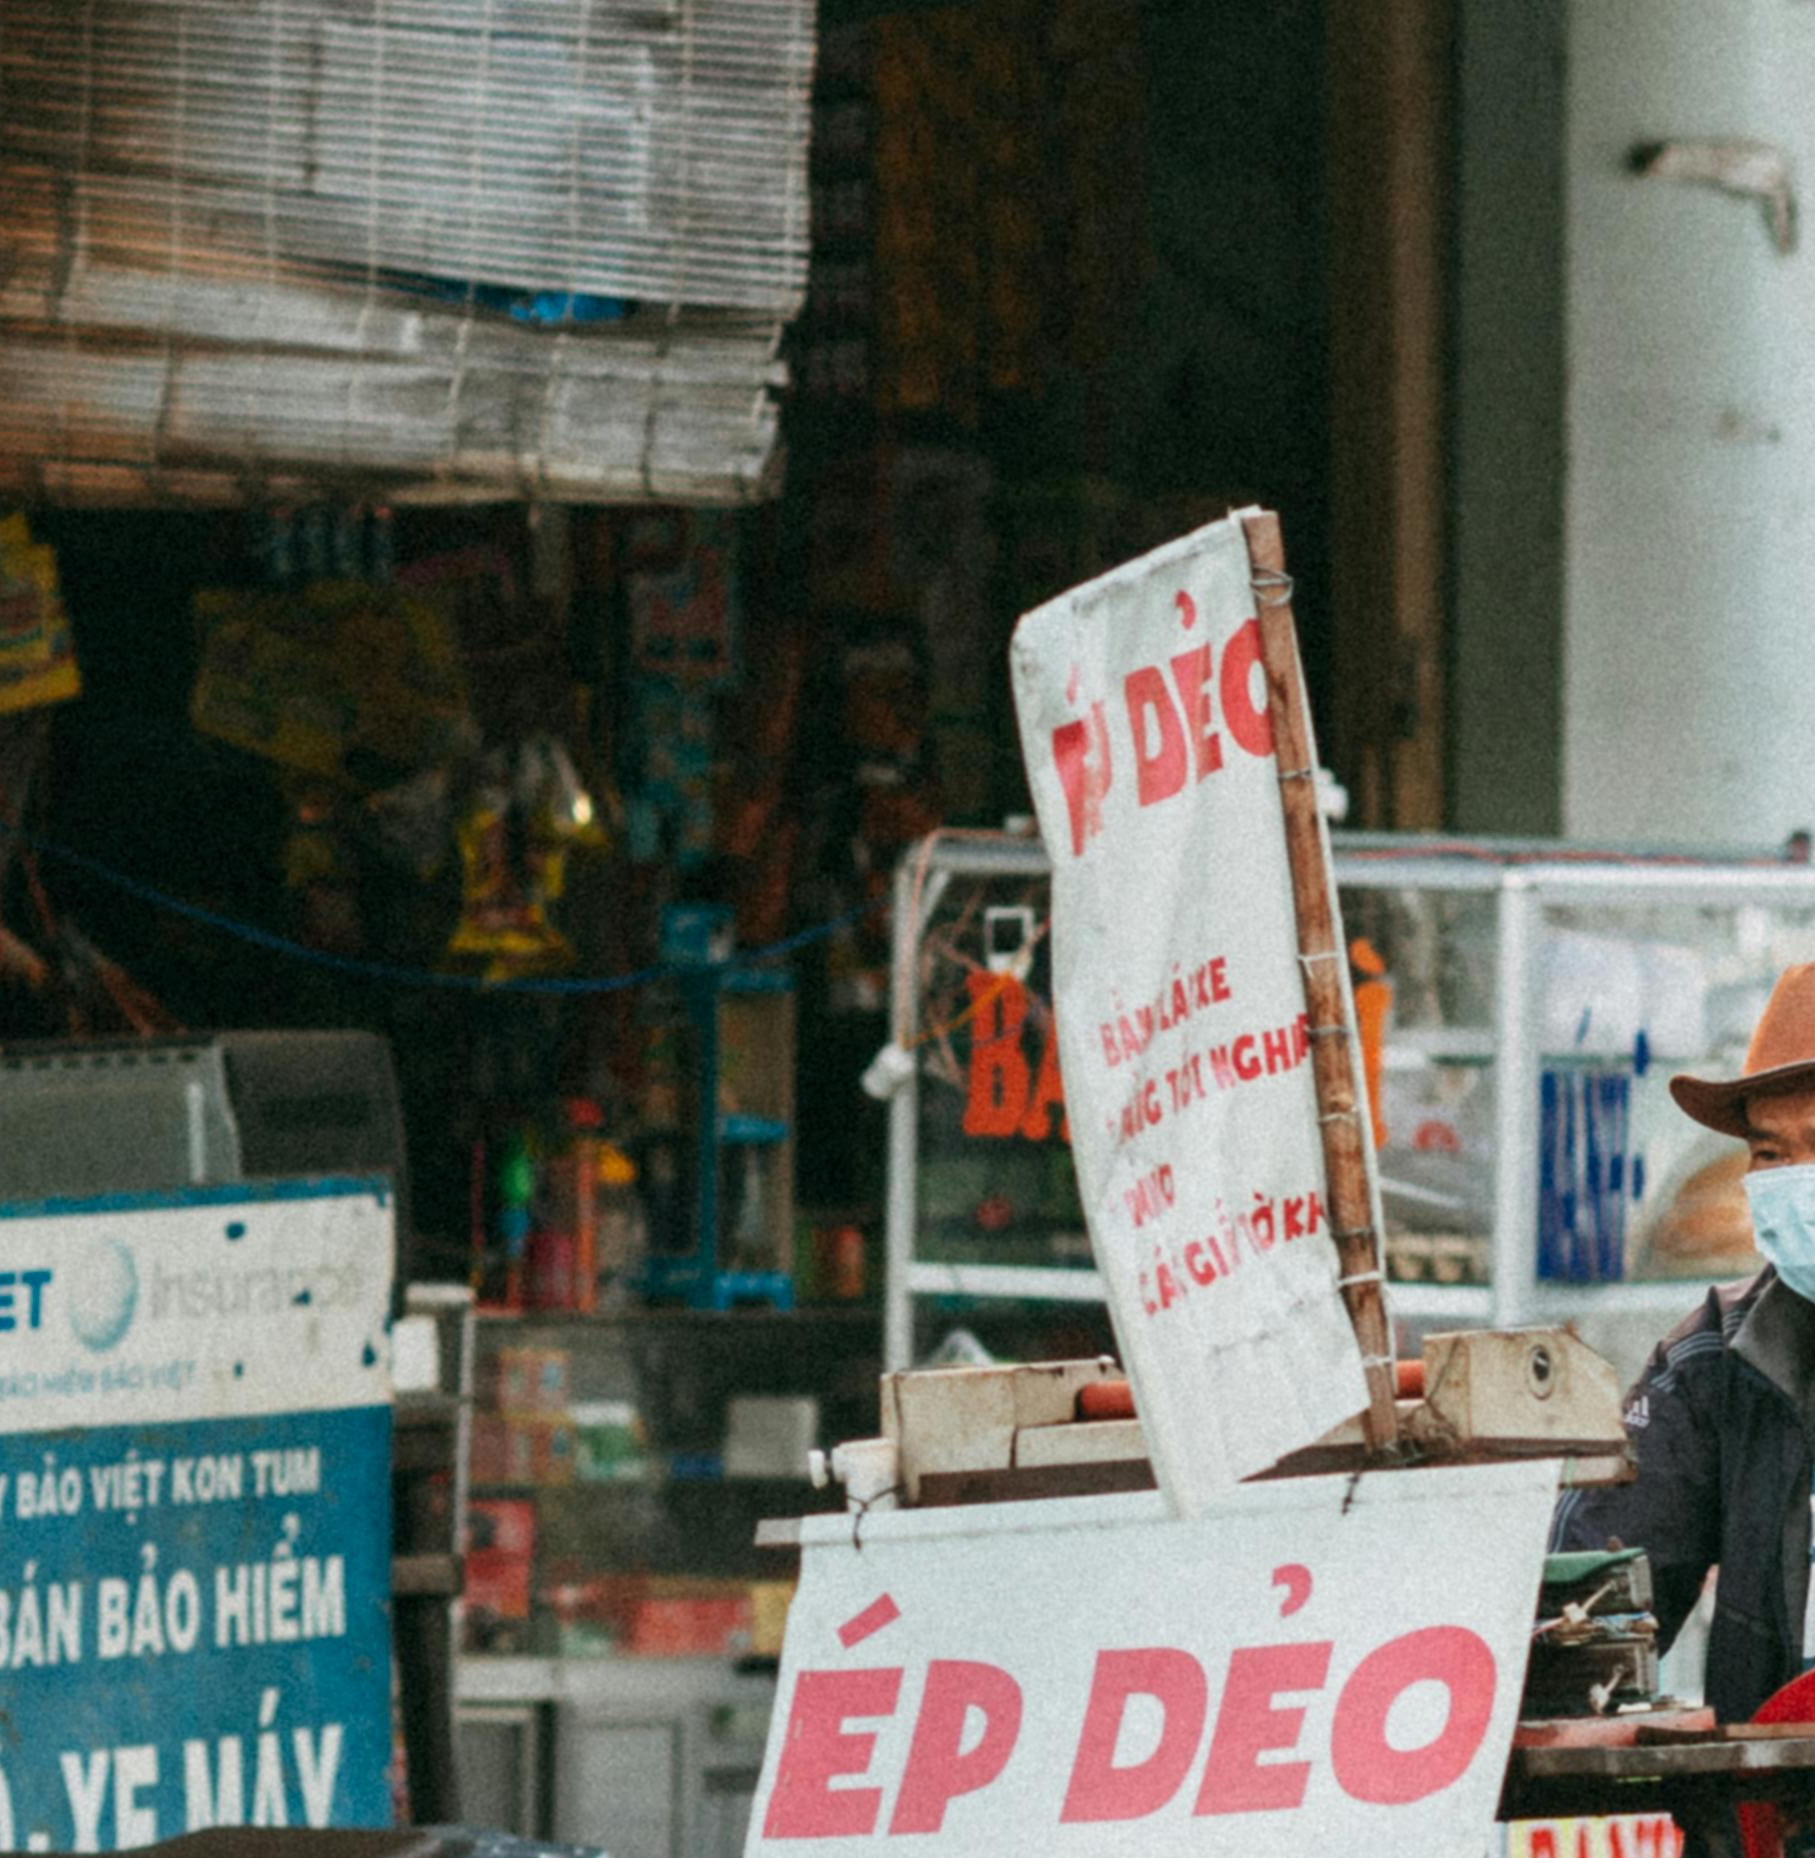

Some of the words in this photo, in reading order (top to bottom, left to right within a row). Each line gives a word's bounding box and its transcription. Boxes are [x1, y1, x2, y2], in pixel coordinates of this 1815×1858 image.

[16, 1453, 83, 1519] BẢO
[91, 1449, 165, 1525] VIỆT
[172, 1453, 242, 1504] KON
[251, 1447, 322, 1495] TUM
[97, 1543, 199, 1659] BẢO
[215, 1513, 347, 1647] HIỂM
[184, 1687, 342, 1831] MÁY
[762, 1591, 1023, 1840] ÉP
[1059, 1563, 1498, 1824] DẺO
